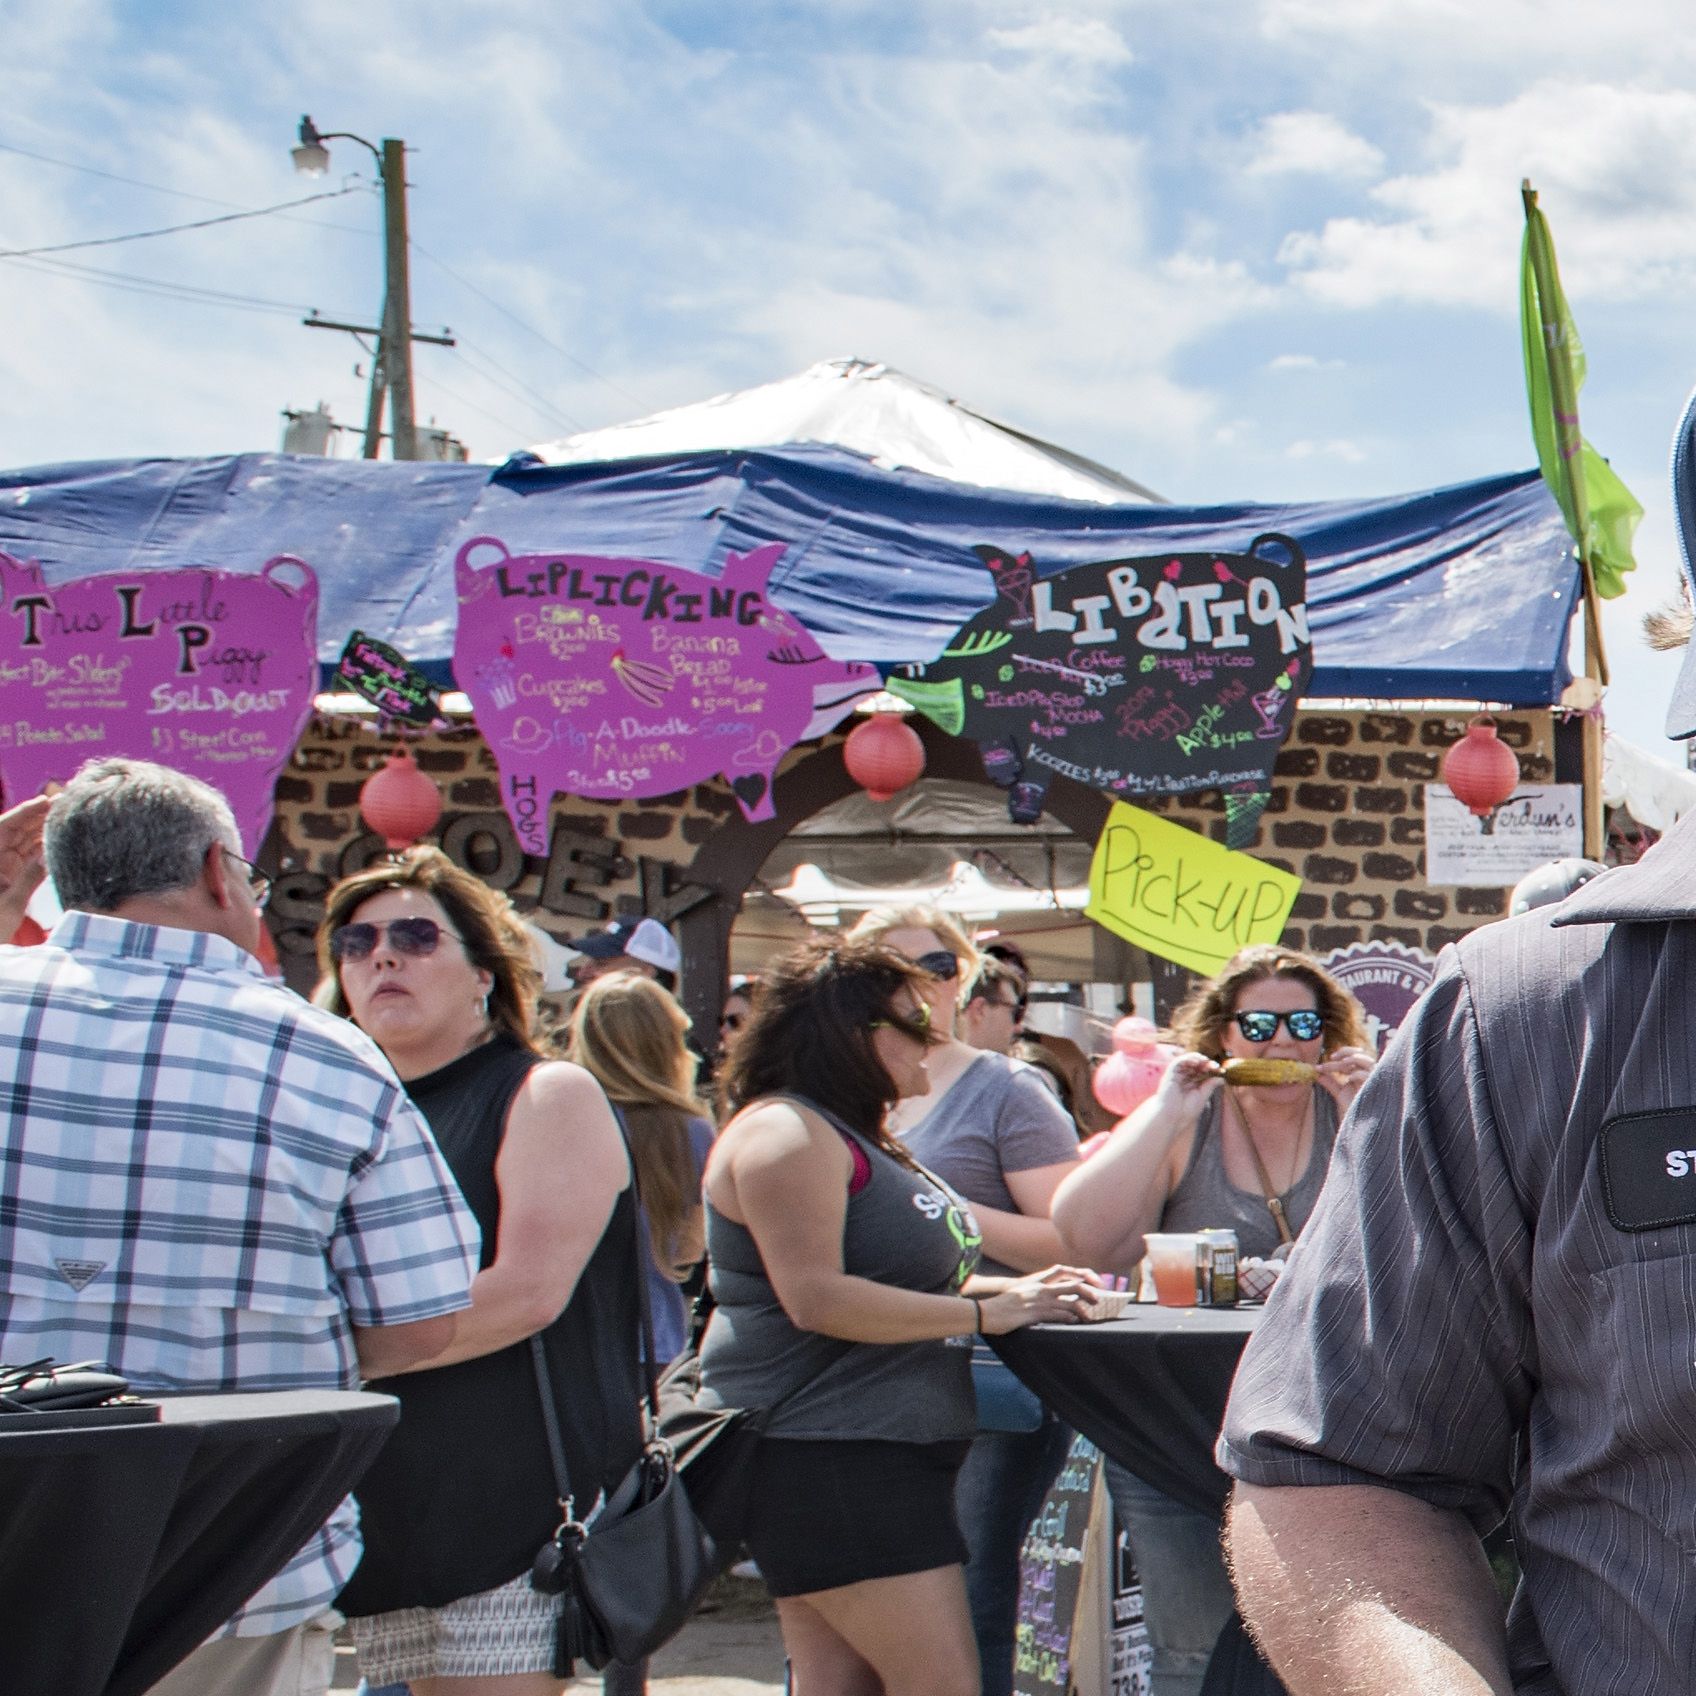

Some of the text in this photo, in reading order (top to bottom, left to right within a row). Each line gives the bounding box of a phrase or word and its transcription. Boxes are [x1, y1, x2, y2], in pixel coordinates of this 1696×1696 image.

[117, 575, 227, 638] Little
[497, 561, 764, 626] LIPLICKING
[1175, 703, 1226, 757] Apple
